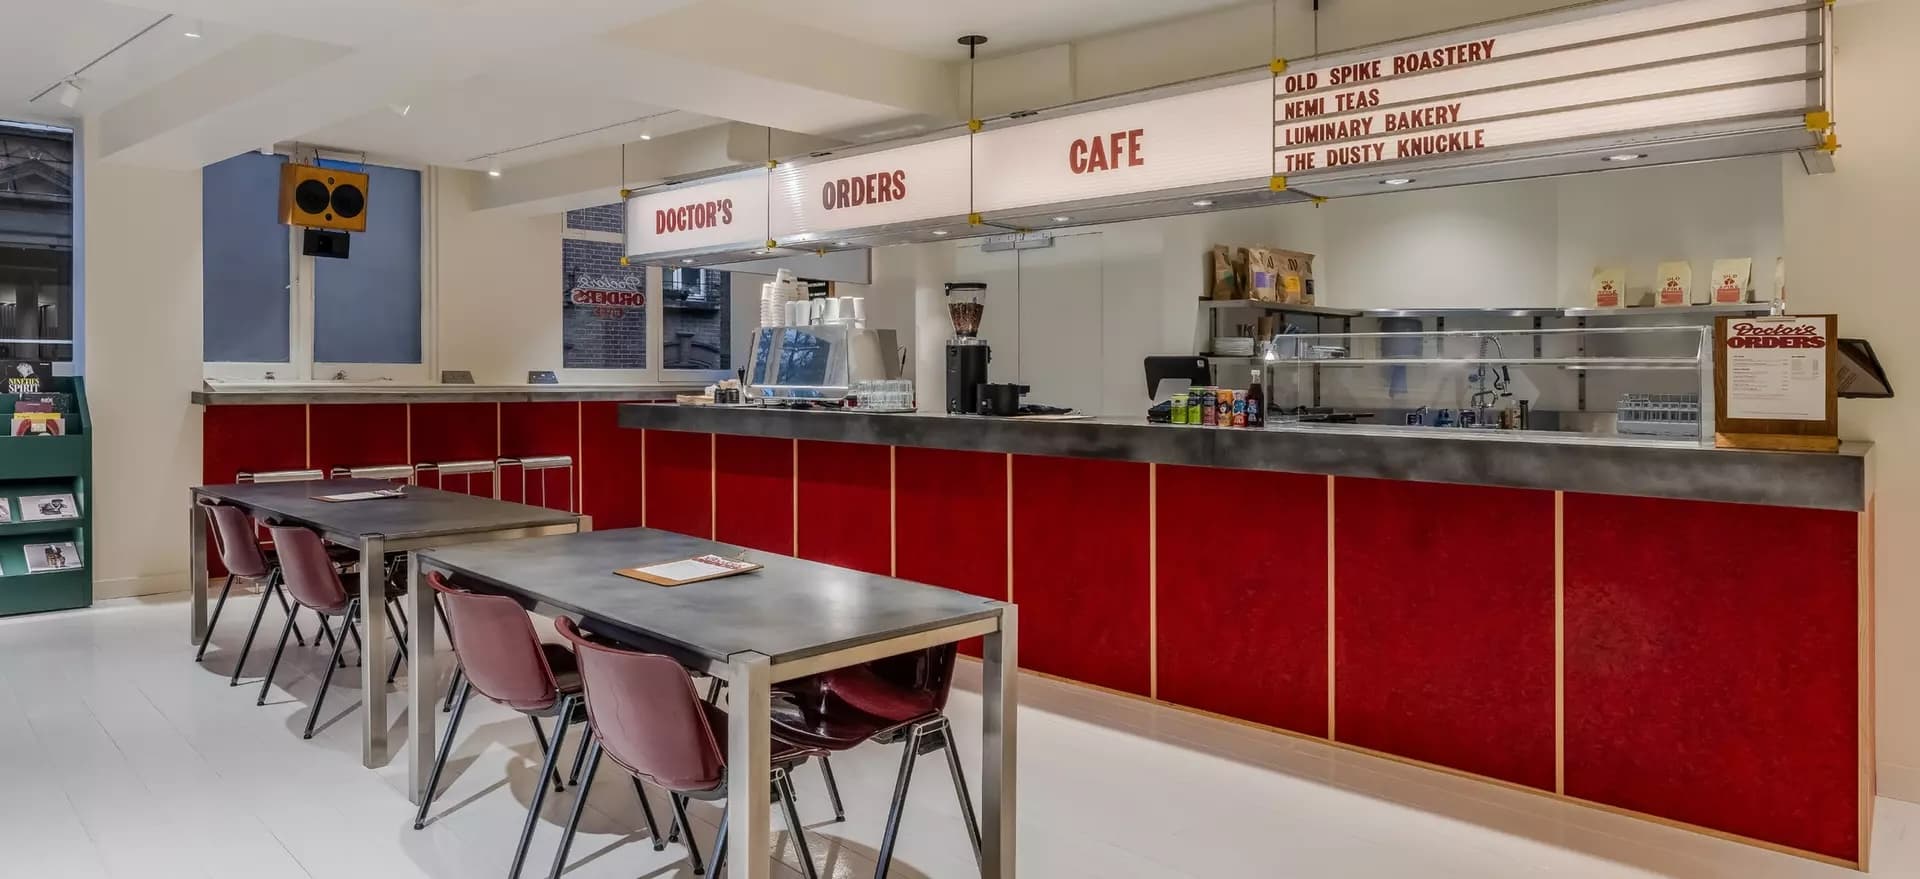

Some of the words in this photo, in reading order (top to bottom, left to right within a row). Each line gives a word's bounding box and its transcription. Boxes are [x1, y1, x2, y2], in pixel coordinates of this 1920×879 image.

[1285, 73, 1318, 93] OLD
[1330, 60, 1381, 86] SPIKE
[1393, 39, 1496, 75] ROASTERY
[1285, 98, 1324, 120] NEMI
[1335, 88, 1380, 112] TEAS
[1285, 116, 1373, 146] LUMINARY
[1385, 103, 1462, 132] BAKERY
[1285, 152, 1316, 172] THE
[1327, 142, 1385, 167] DUSTY
[1397, 129, 1485, 158] KNUCKLE
[656, 198, 733, 235] DOCTOR'S
[822, 169, 906, 210] ORDERS
[1069, 128, 1145, 174] CAFE
[1726, 336, 1826, 349] ORDERS
[1732, 322, 1817, 336] Doctor's
[8, 384, 39, 393] SPIRIT
